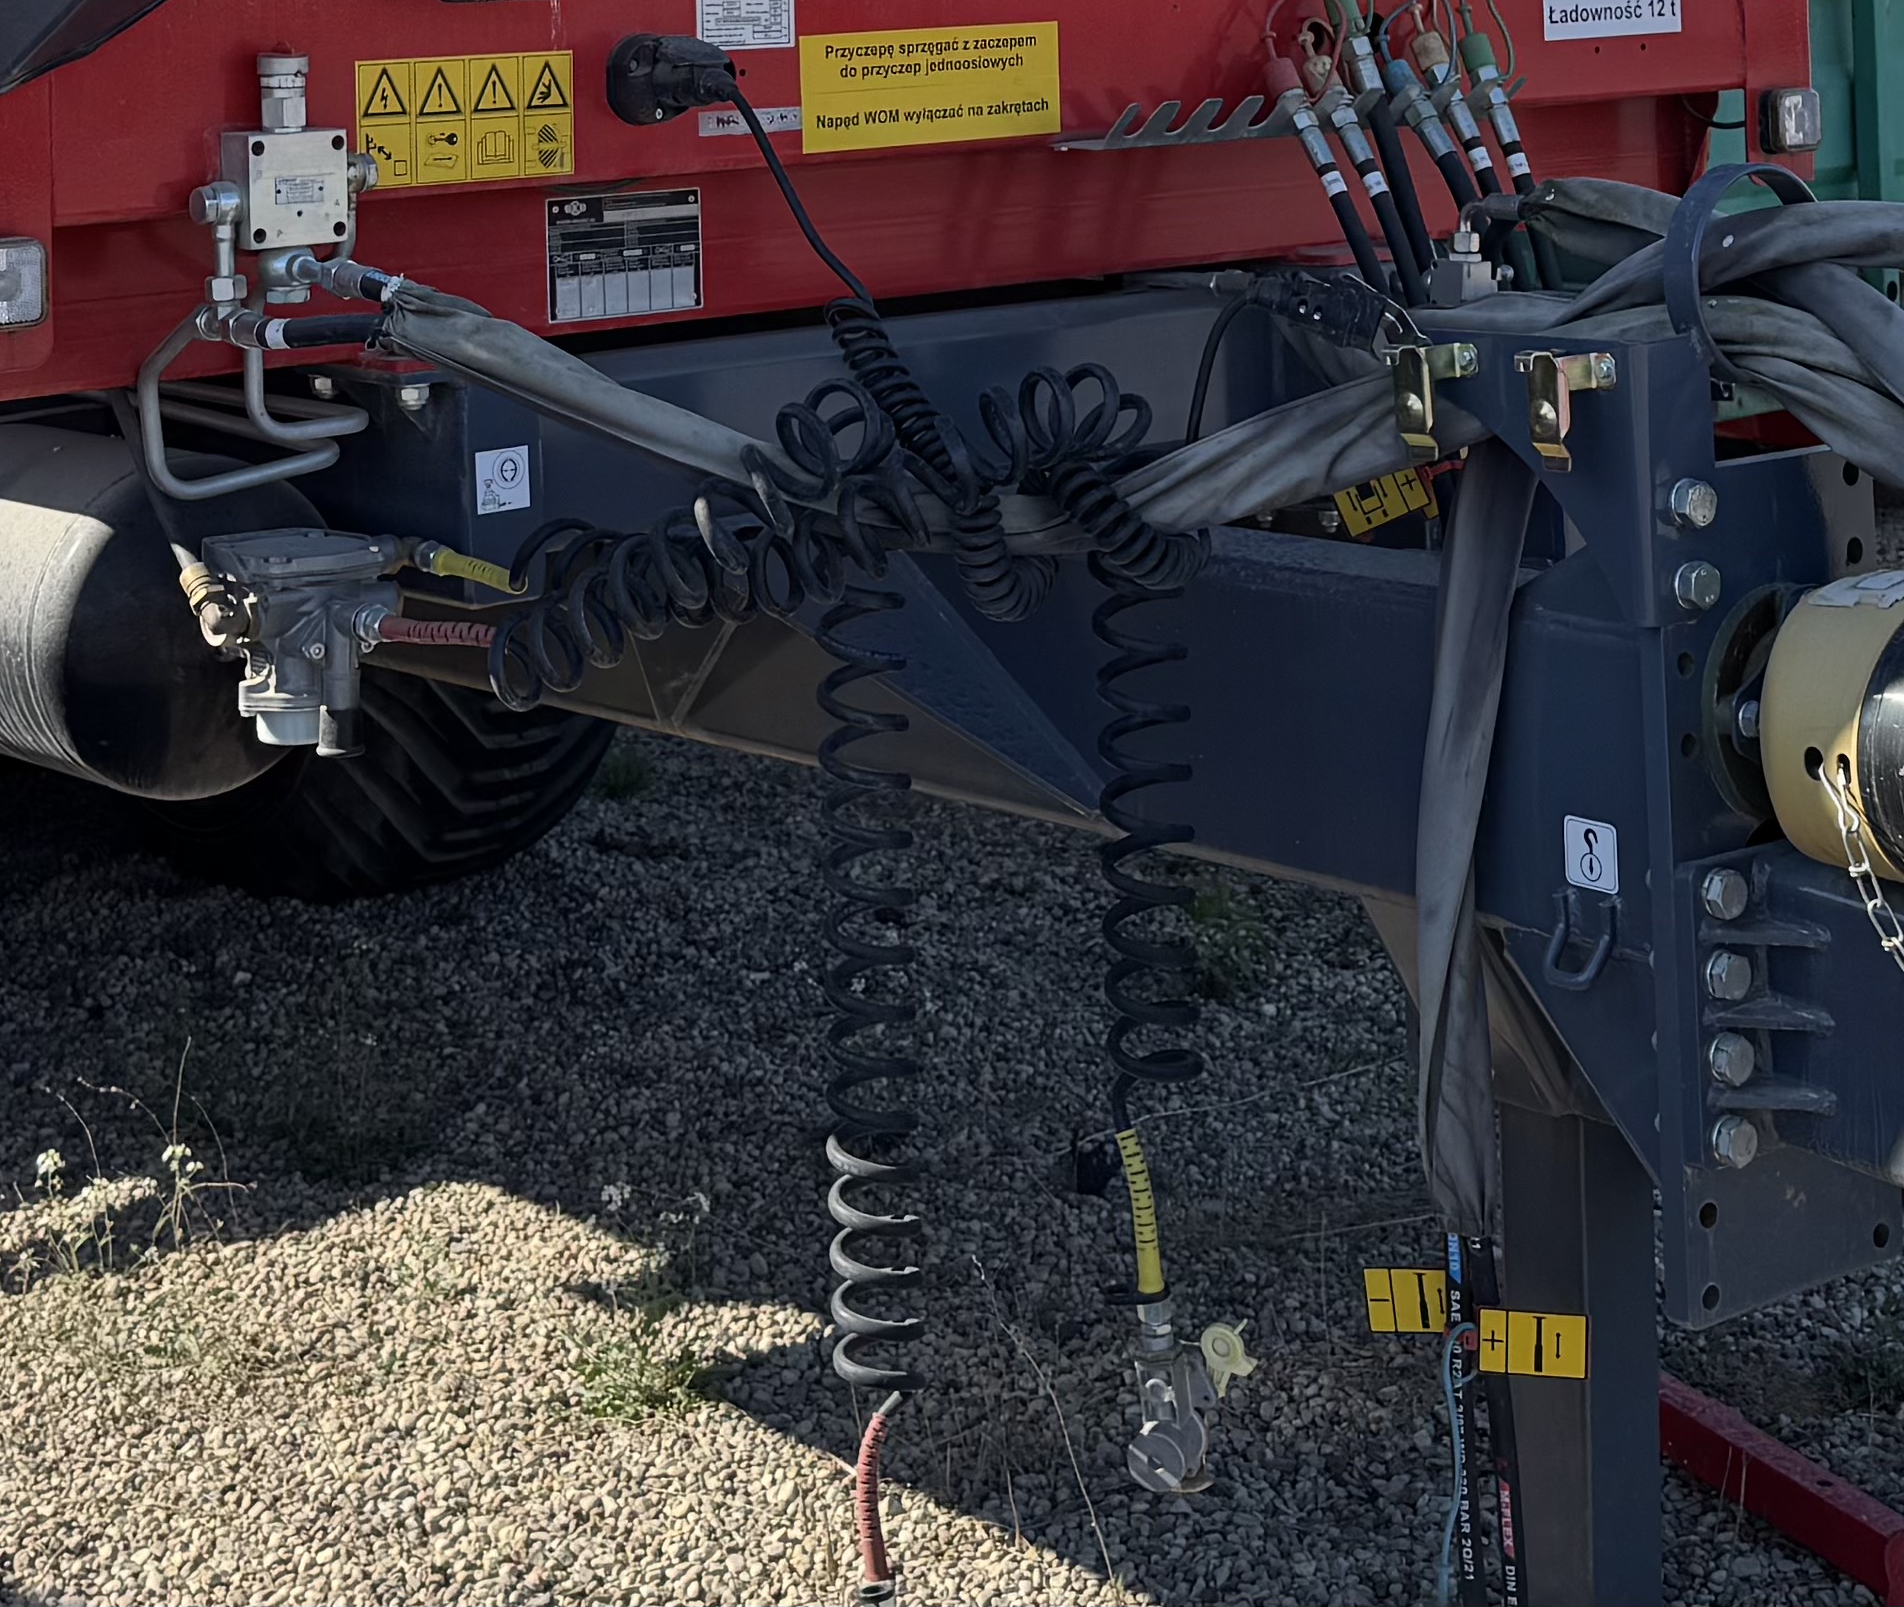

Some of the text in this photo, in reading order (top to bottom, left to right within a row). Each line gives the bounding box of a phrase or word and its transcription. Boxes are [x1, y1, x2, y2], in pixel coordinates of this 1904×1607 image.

[1548, 0, 1643, 24] Ładowność
[1670, 0, 1676, 17] t
[825, 35, 1037, 60] Przyczepę sprzęgać z zaczepem
[840, 53, 1024, 80] do przyczep jednoosiowych
[816, 112, 860, 131] Napęd
[864, 109, 900, 125] WOM
[903, 104, 964, 127] wyłączać
[968, 105, 984, 117] na
[987, 98, 1049, 117] zakrętach
[1450, 1289, 1462, 1323] SAE
[1505, 1566, 1517, 1592] DIN
